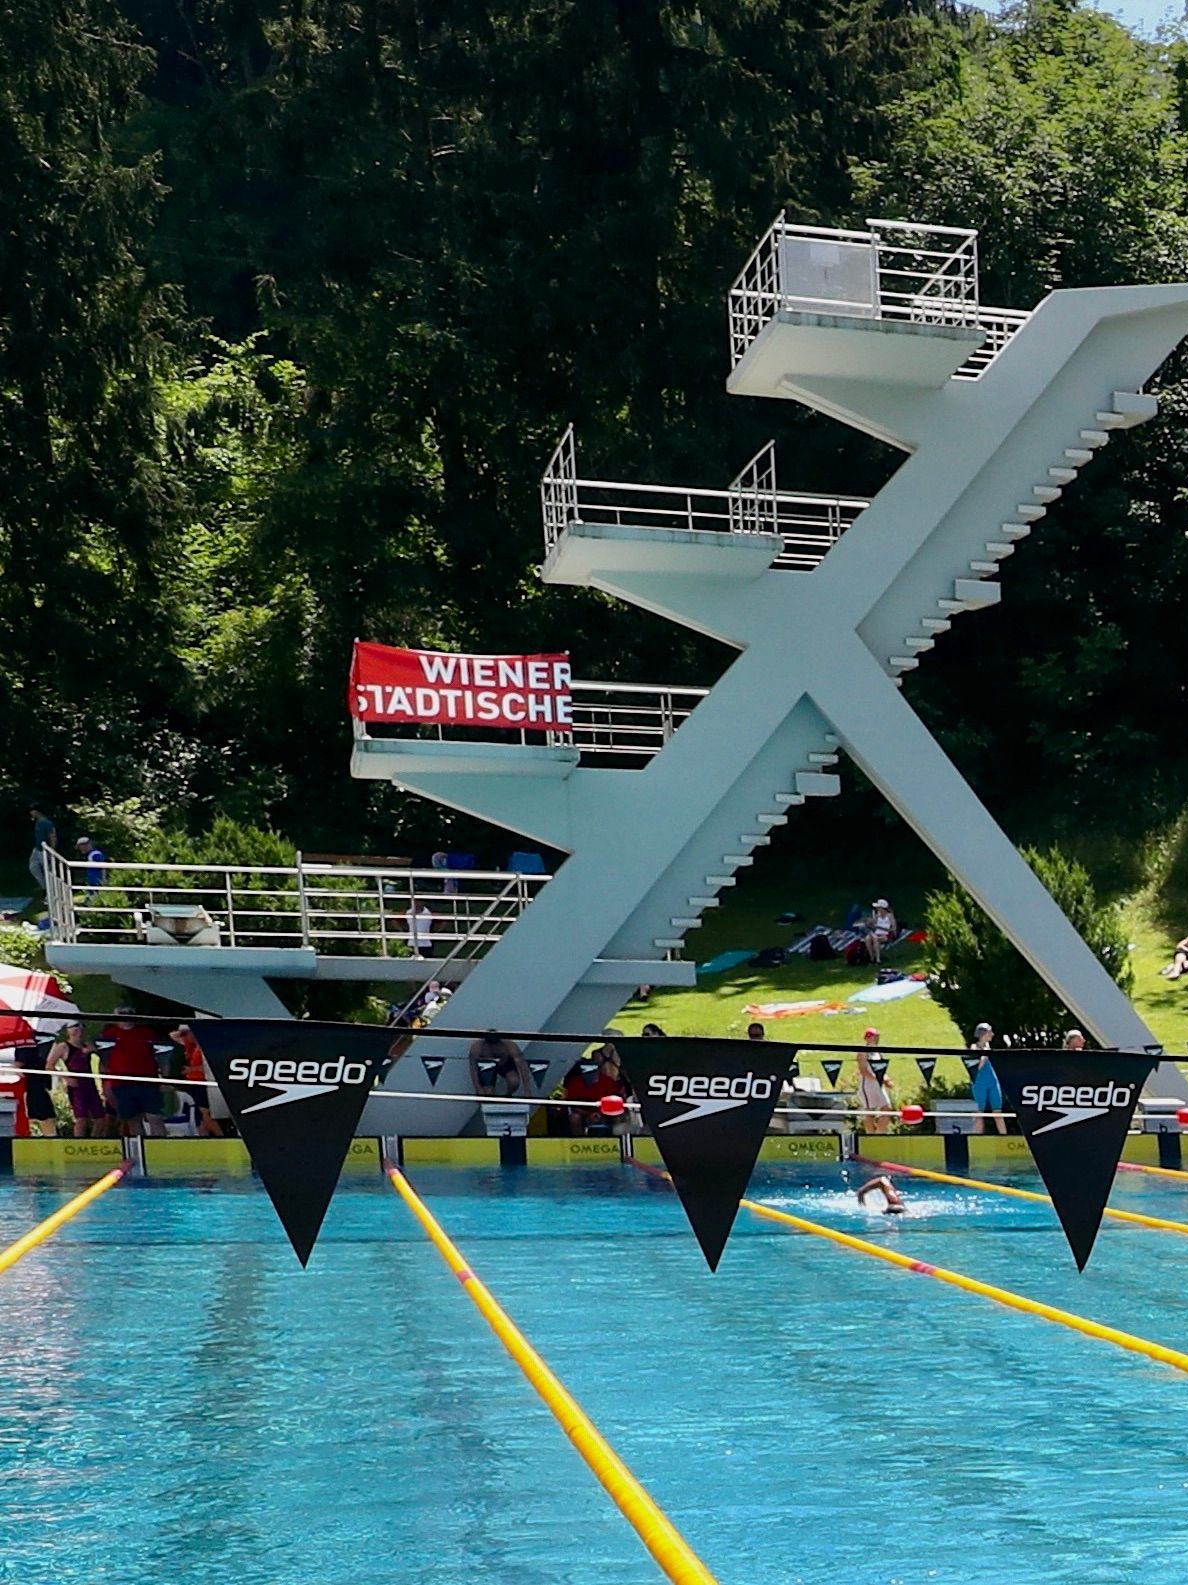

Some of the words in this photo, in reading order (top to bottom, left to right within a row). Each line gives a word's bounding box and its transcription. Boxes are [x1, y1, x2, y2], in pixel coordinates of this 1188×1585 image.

[419, 655, 571, 690] WIENER
[229, 1056, 367, 1087] speedo
[648, 1072, 771, 1102] speedo
[1022, 1080, 1131, 1111] speedo
[64, 1145, 121, 1156] OMEGA
[570, 1144, 619, 1154] OMEGA
[788, 1141, 834, 1152] OMEGA
